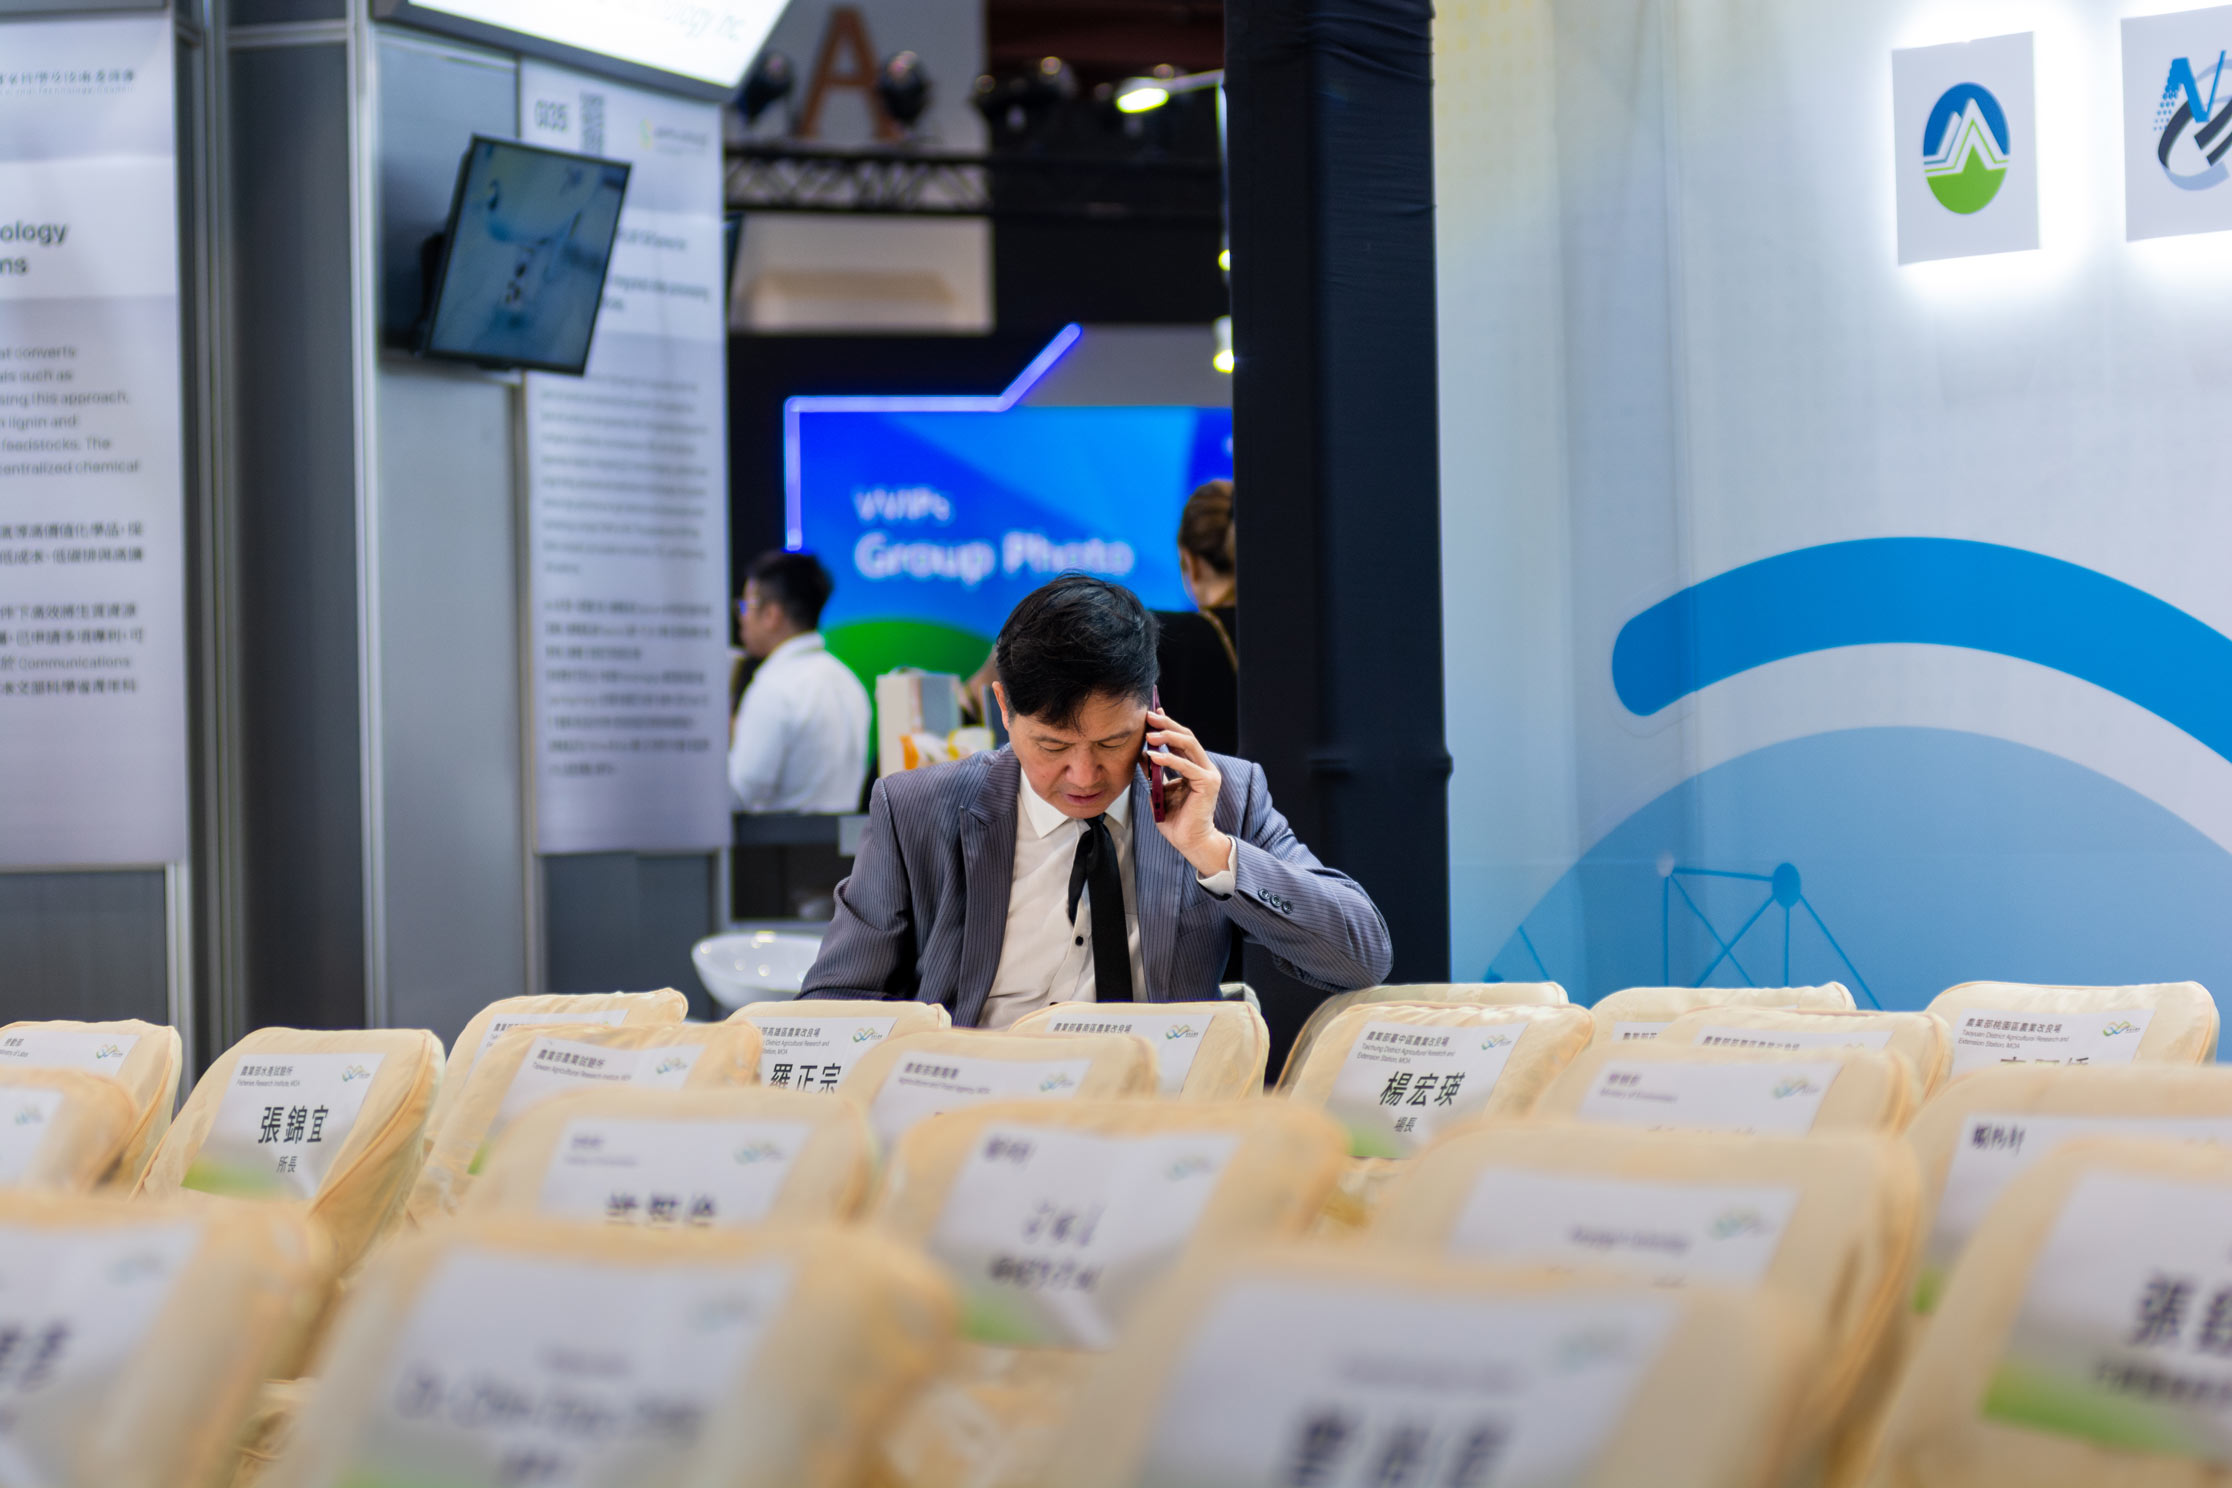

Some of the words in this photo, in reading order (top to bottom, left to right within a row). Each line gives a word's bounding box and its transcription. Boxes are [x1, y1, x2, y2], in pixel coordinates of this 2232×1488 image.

[853, 531, 997, 586] Group
[1002, 530, 1136, 576] Photo
[18, 655, 131, 671] Communications
[757, 1026, 822, 1039] 部高雄區農業改良場
[1965, 1018, 2063, 1033] 農業部桃園區農業改良場
[768, 1062, 842, 1095] 羅正宗
[1379, 1070, 1467, 1107] 楊宏瑛
[257, 1104, 329, 1145] 張錦宜
[276, 1155, 298, 1174] 所長
